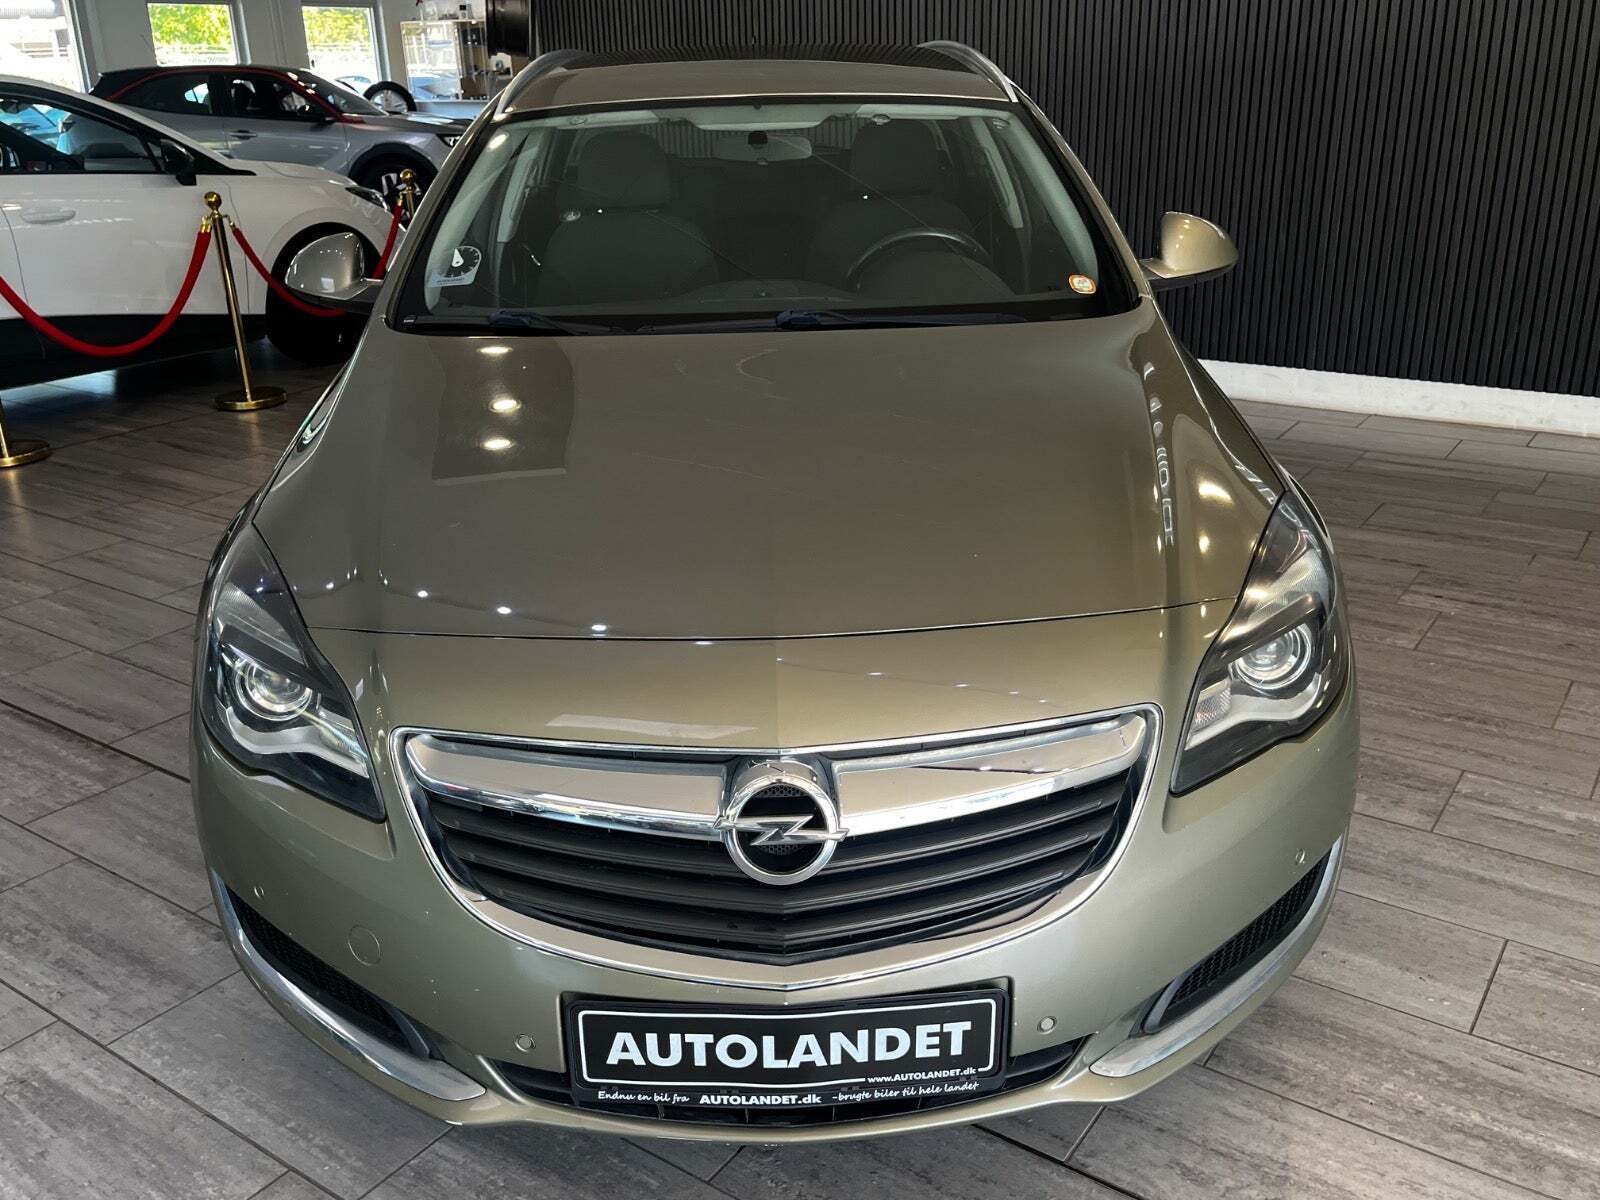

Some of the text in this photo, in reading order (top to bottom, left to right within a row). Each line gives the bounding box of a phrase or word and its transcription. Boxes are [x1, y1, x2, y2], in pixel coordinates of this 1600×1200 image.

[605, 1021, 972, 1069] AUTOLANDET
[867, 1067, 977, 1083] www.AUTOLANDET.dk
[597, 1090, 636, 1101] Endnu
[653, 1092, 671, 1103] bil
[671, 1093, 690, 1105] fra
[699, 1094, 822, 1105] AUTOLANDET.dk
[873, 1088, 900, 1099] biler
[901, 1084, 917, 1096] til
[918, 1084, 942, 1096] hele
[944, 1081, 980, 1093] landet
